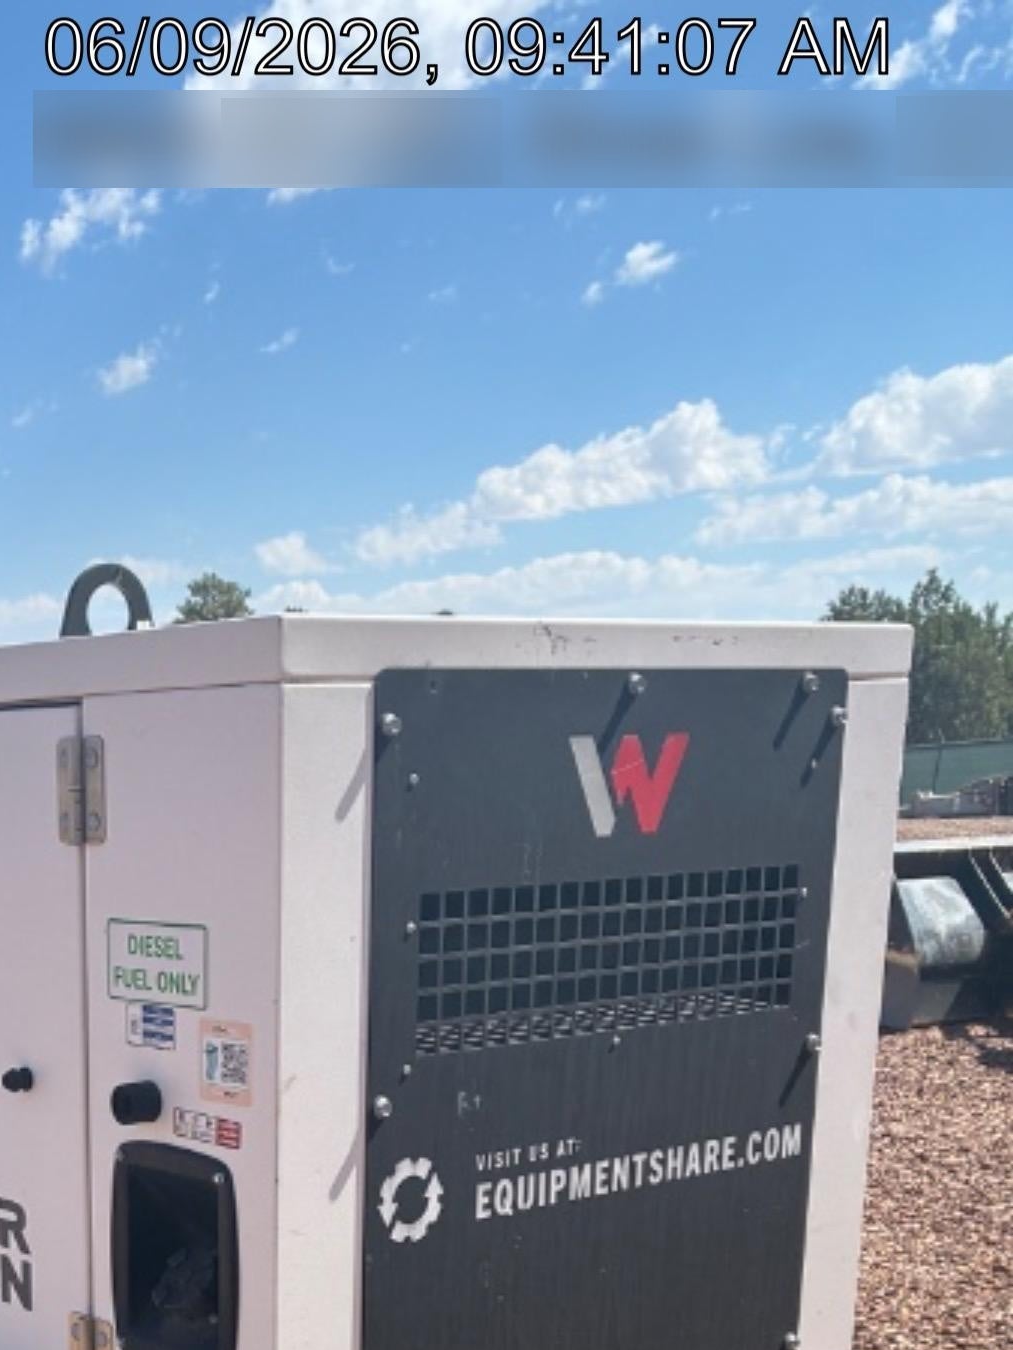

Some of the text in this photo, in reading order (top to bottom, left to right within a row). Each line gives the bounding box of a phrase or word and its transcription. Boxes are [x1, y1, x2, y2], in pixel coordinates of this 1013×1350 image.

[127, 933, 183, 960] DIESEL
[113, 966, 201, 996] FUEL ONLY
[475, 1148, 521, 1172] VISIT
[529, 1142, 549, 1163] US
[475, 1122, 802, 1220] EQUIPMENTSHARE.COM
